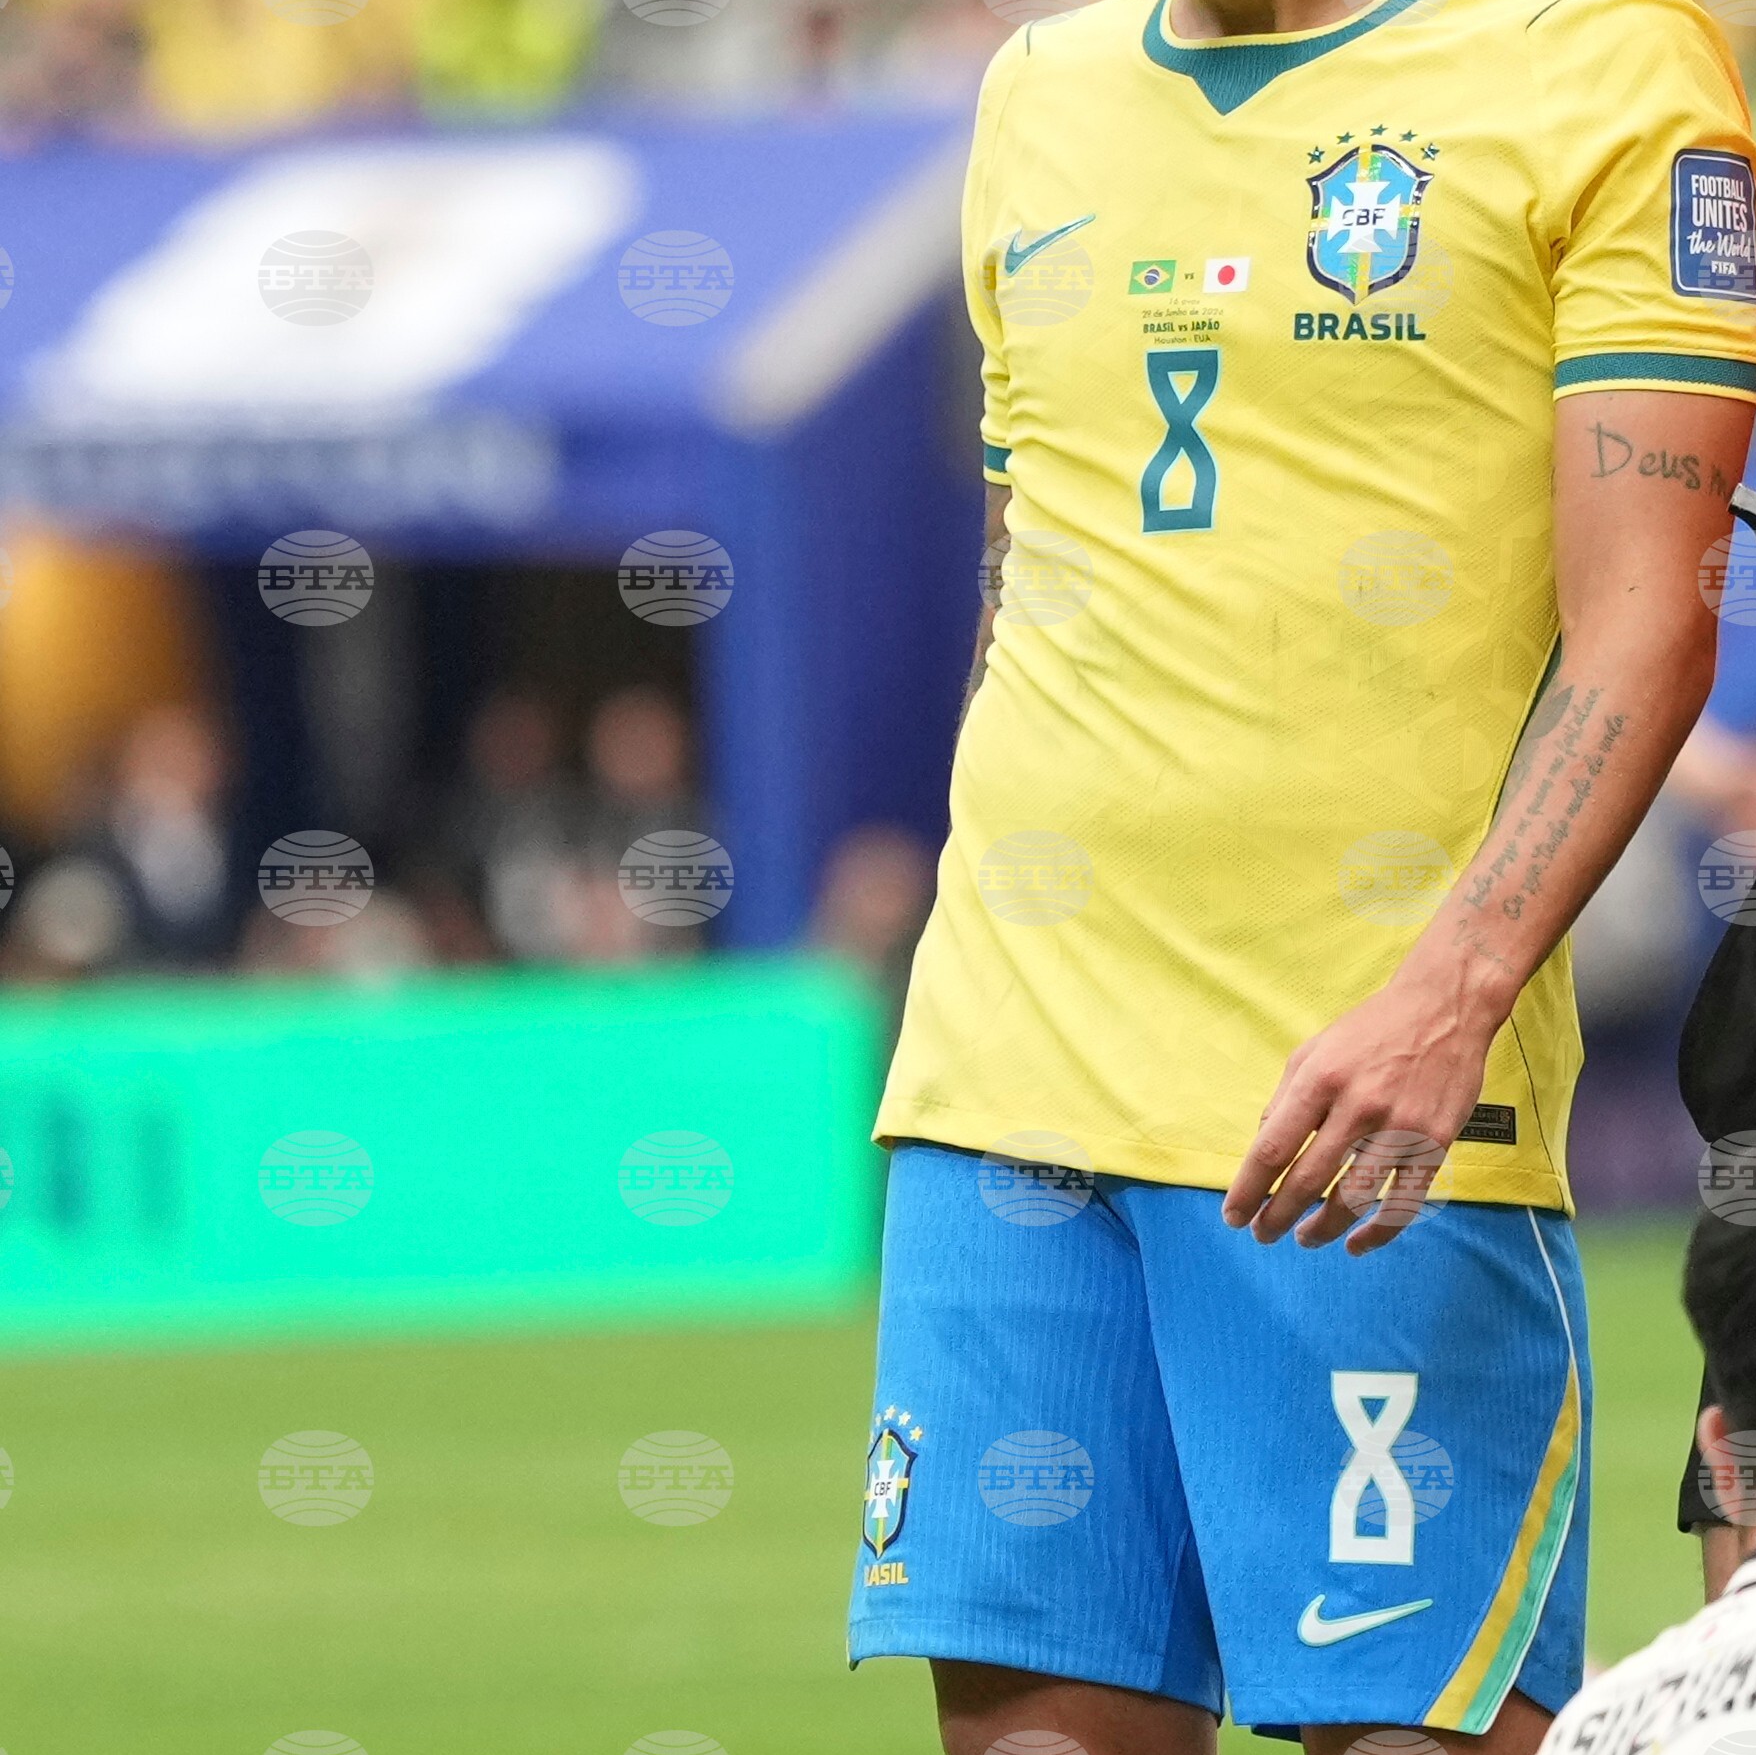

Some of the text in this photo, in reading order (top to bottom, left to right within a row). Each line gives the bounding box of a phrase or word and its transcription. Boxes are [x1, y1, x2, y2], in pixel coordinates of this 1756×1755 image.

[1690, 174, 1747, 202] FOOTBALL
[1341, 207, 1387, 227] CBF
[1691, 197, 1748, 234] UNITES
[1686, 229, 1751, 264] the World
[1711, 260, 1738, 276] FIFA
[1293, 312, 1428, 342] BRASIL
[1140, 348, 1220, 534] 8
[1587, 421, 1701, 491] Deus
[1329, 1370, 1420, 1567] 8
[873, 1480, 893, 1498] CBF
